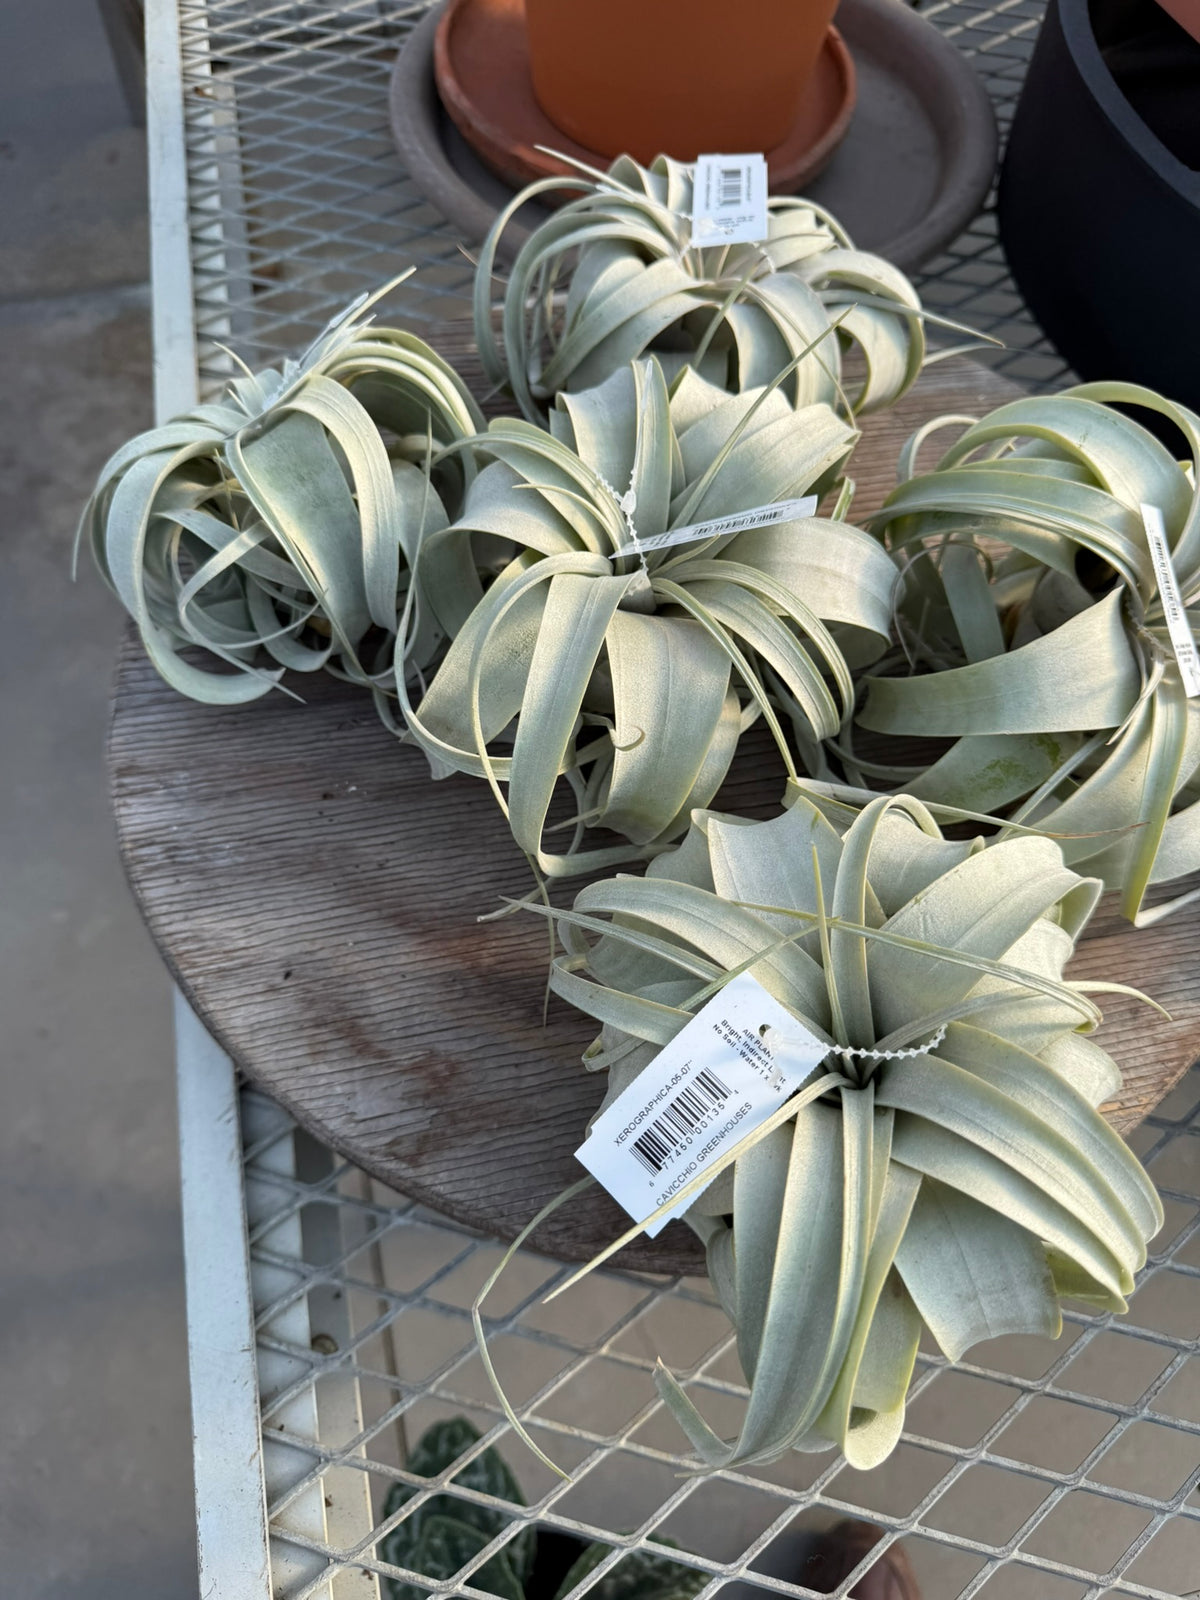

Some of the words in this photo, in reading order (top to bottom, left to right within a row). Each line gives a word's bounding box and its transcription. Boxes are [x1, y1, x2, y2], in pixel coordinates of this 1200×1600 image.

[712, 1024, 722, 1035] No
[722, 1033, 736, 1048] Soil
[739, 1050, 760, 1070] Water
[742, 1029, 755, 1041] AIR
[742, 1040, 769, 1069] Indirect
[649, 1180, 655, 1188] 6
[661, 1136, 693, 1171] 77450
[695, 1102, 725, 1135] 00135
[655, 1162, 698, 1207] CAVICCHIO
[696, 1102, 753, 1163] GREENHOUSES
